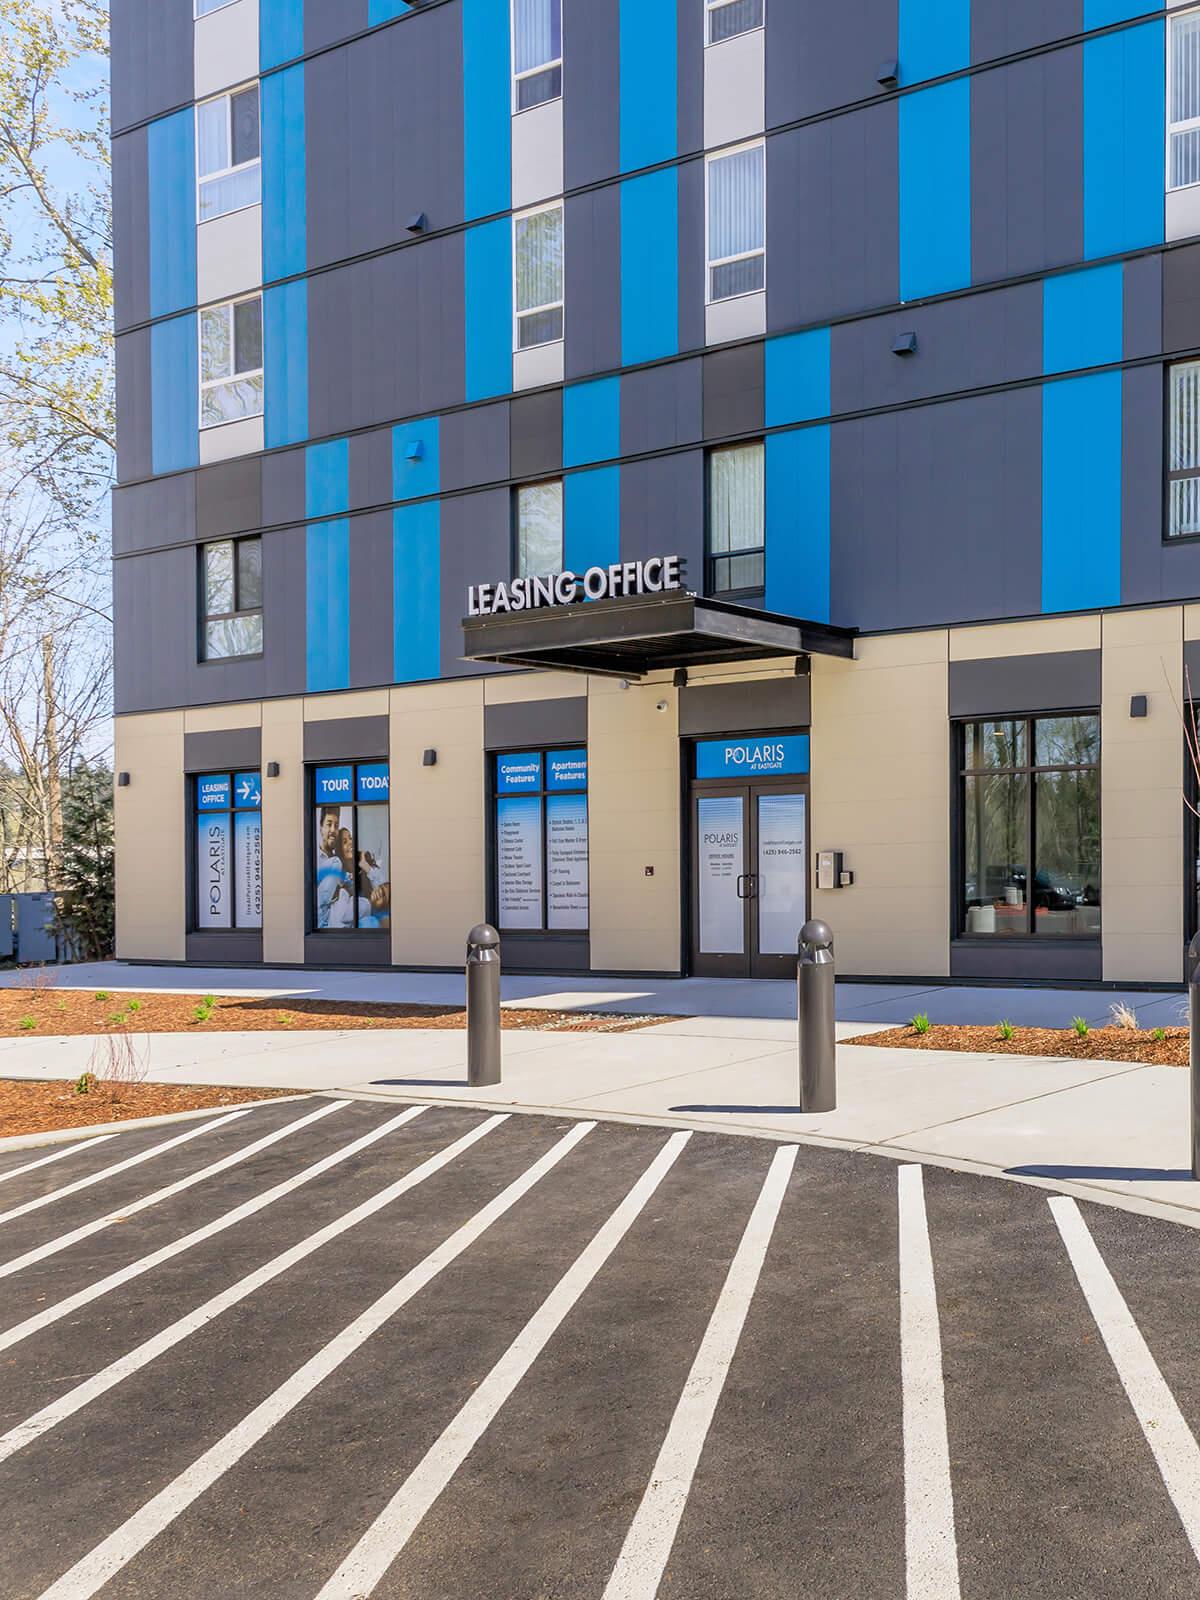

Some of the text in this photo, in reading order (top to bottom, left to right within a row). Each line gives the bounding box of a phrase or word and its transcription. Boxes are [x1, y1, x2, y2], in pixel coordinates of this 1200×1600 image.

[468, 555, 681, 616] LEASING OFFICE
[725, 744, 785, 765] POLARIS
[501, 763, 539, 773] Community
[551, 761, 587, 771] Apartmen
[506, 775, 535, 783] Features
[554, 772, 586, 781] Features
[202, 783, 228, 793] LEASING
[322, 776, 389, 791] TOUR TODA
[202, 794, 225, 803] OFFICE
[704, 833, 738, 843] POLARIS
[209, 826, 221, 915] POLARIS
